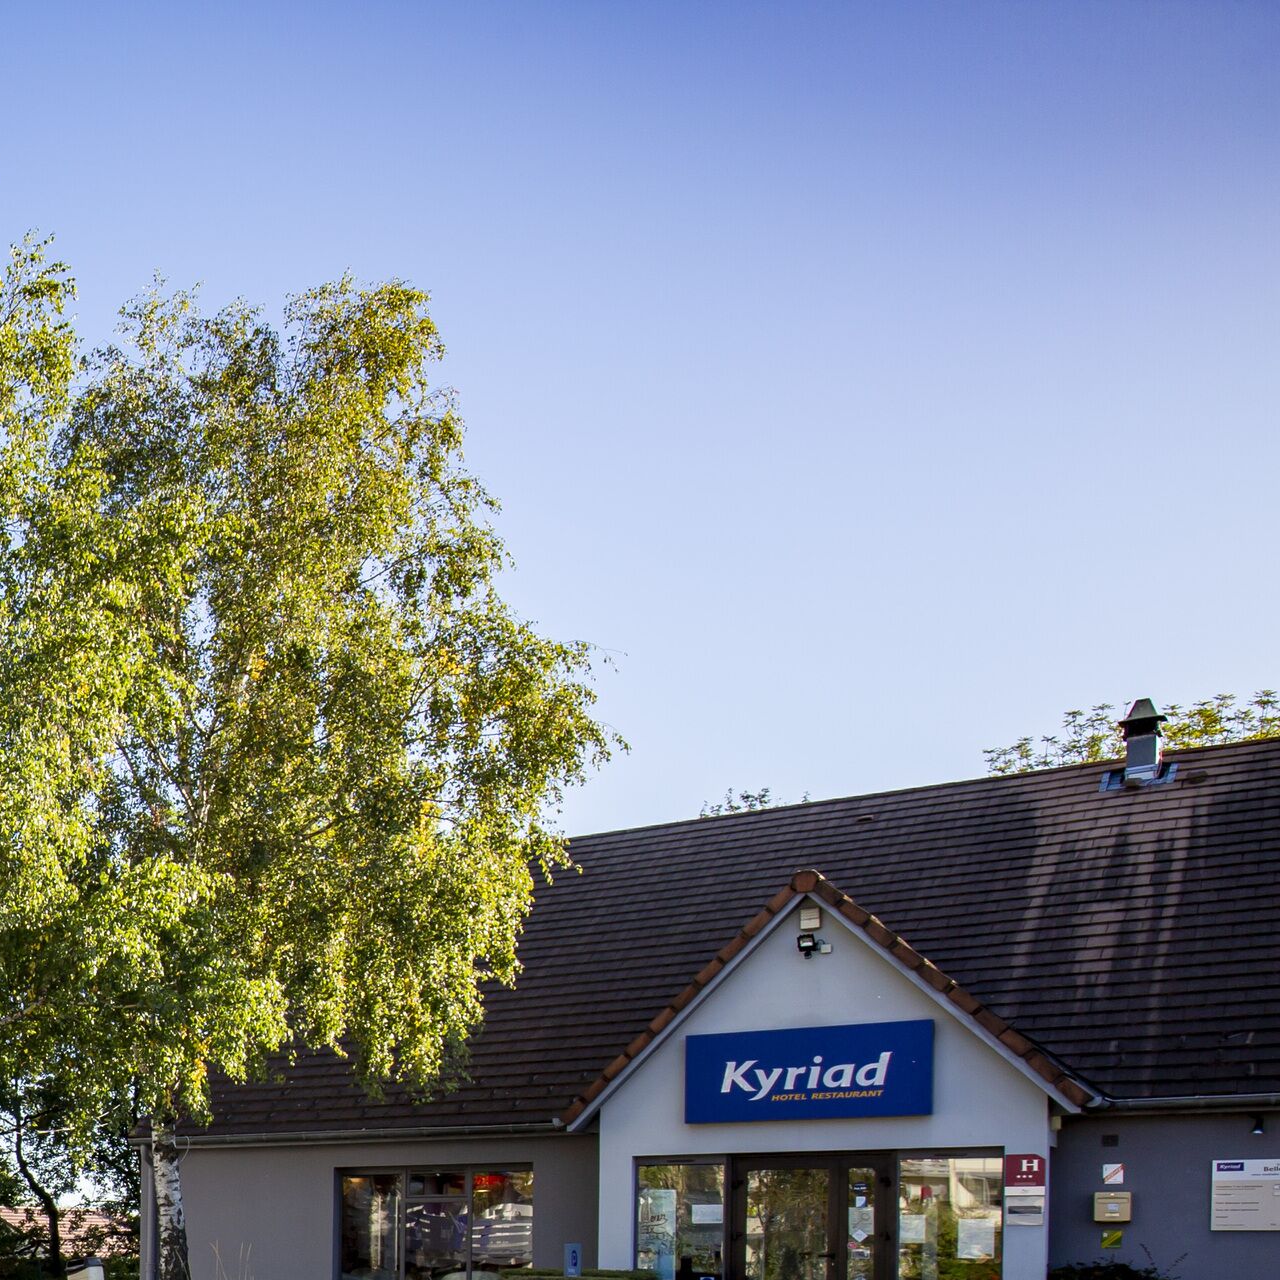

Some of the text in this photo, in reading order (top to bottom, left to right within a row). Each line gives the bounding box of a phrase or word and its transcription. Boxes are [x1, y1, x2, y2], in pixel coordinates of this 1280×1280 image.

[720, 1051, 893, 1101] Kyriad
[771, 1090, 884, 1102] HOTEL RESTAURANT
[1021, 1159, 1040, 1172] H
